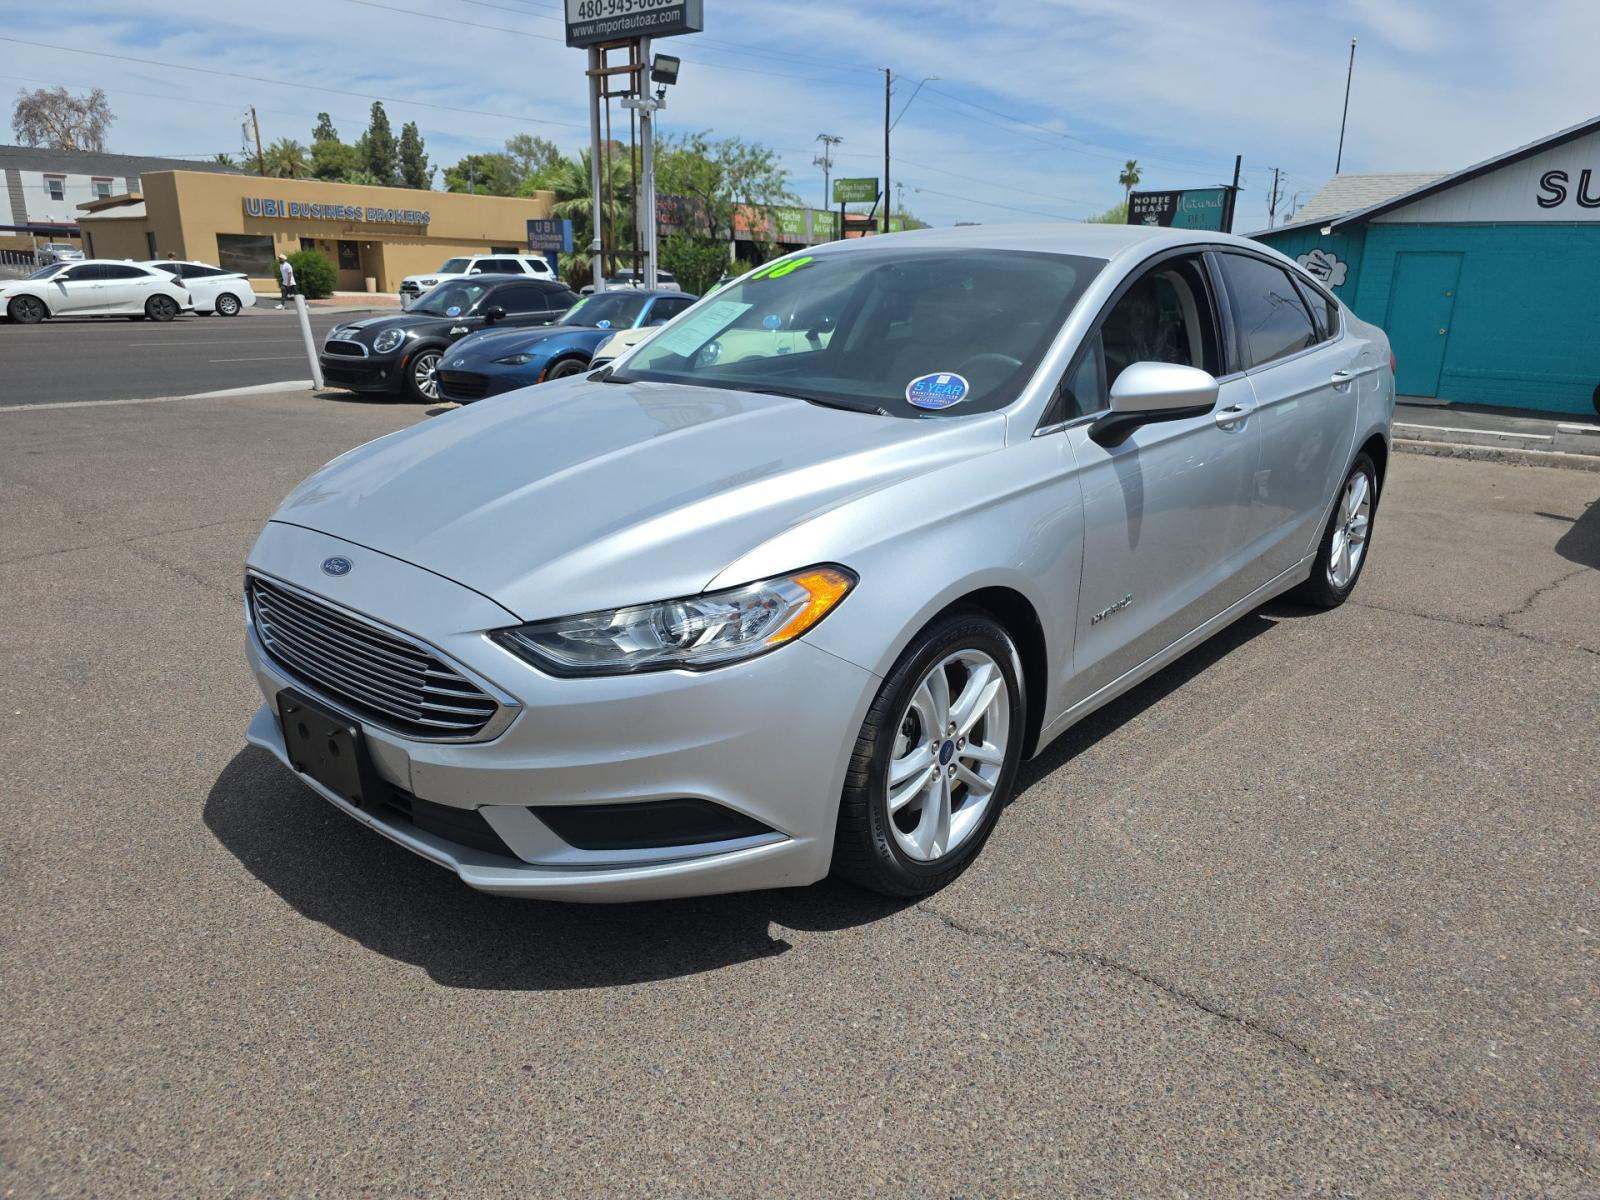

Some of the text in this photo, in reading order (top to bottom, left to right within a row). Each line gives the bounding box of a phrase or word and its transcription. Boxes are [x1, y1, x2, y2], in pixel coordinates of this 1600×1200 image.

[573, 9, 680, 37] www.importautoaz.com
[1134, 204, 1168, 213] BEAST
[1177, 193, 1223, 213] Natural
[244, 198, 431, 225] UBI BUSINESS BROKERS
[536, 221, 555, 233] UBI
[914, 382, 963, 395] 5 YEAR
